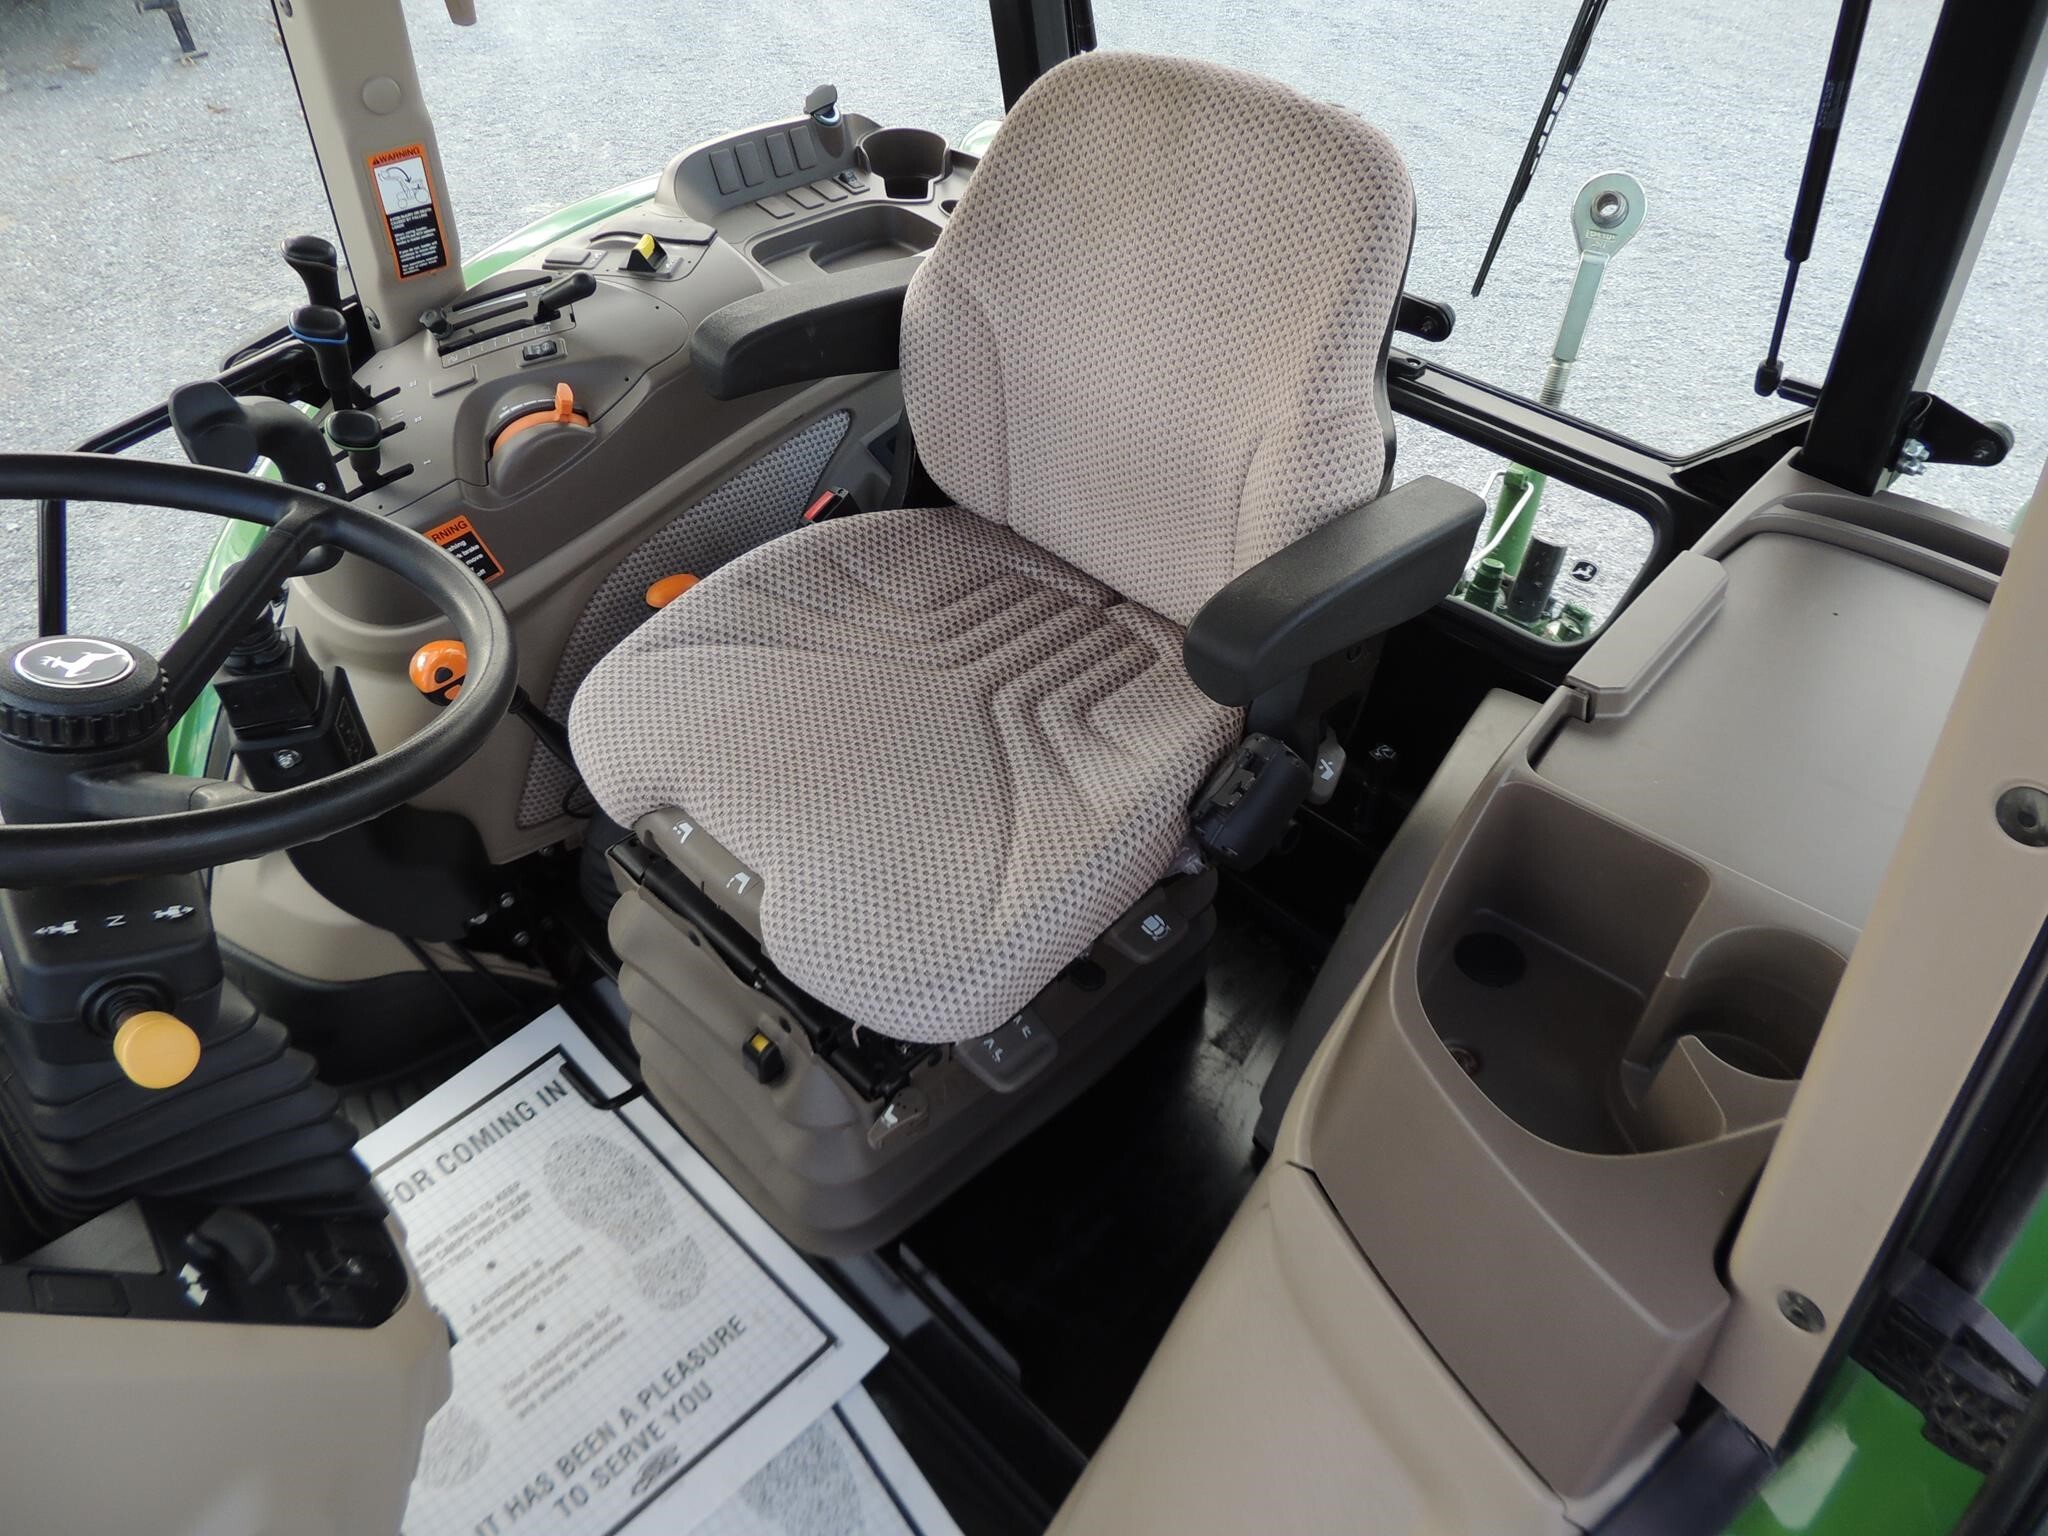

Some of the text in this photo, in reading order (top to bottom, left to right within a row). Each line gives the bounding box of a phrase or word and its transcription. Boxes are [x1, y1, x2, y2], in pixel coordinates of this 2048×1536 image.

[379, 147, 420, 162] WARNING
[431, 520, 468, 543] RNING
[436, 1101, 538, 1175] COMING
[536, 1079, 568, 1108] IN
[504, 1472, 554, 1523] HAS
[557, 1421, 617, 1478] BEEN
[620, 1406, 640, 1429] A
[637, 1314, 746, 1410] PLEASURE
[554, 1483, 589, 1518] TO
[591, 1418, 666, 1489] SERVE
[664, 1379, 713, 1424] YOU
